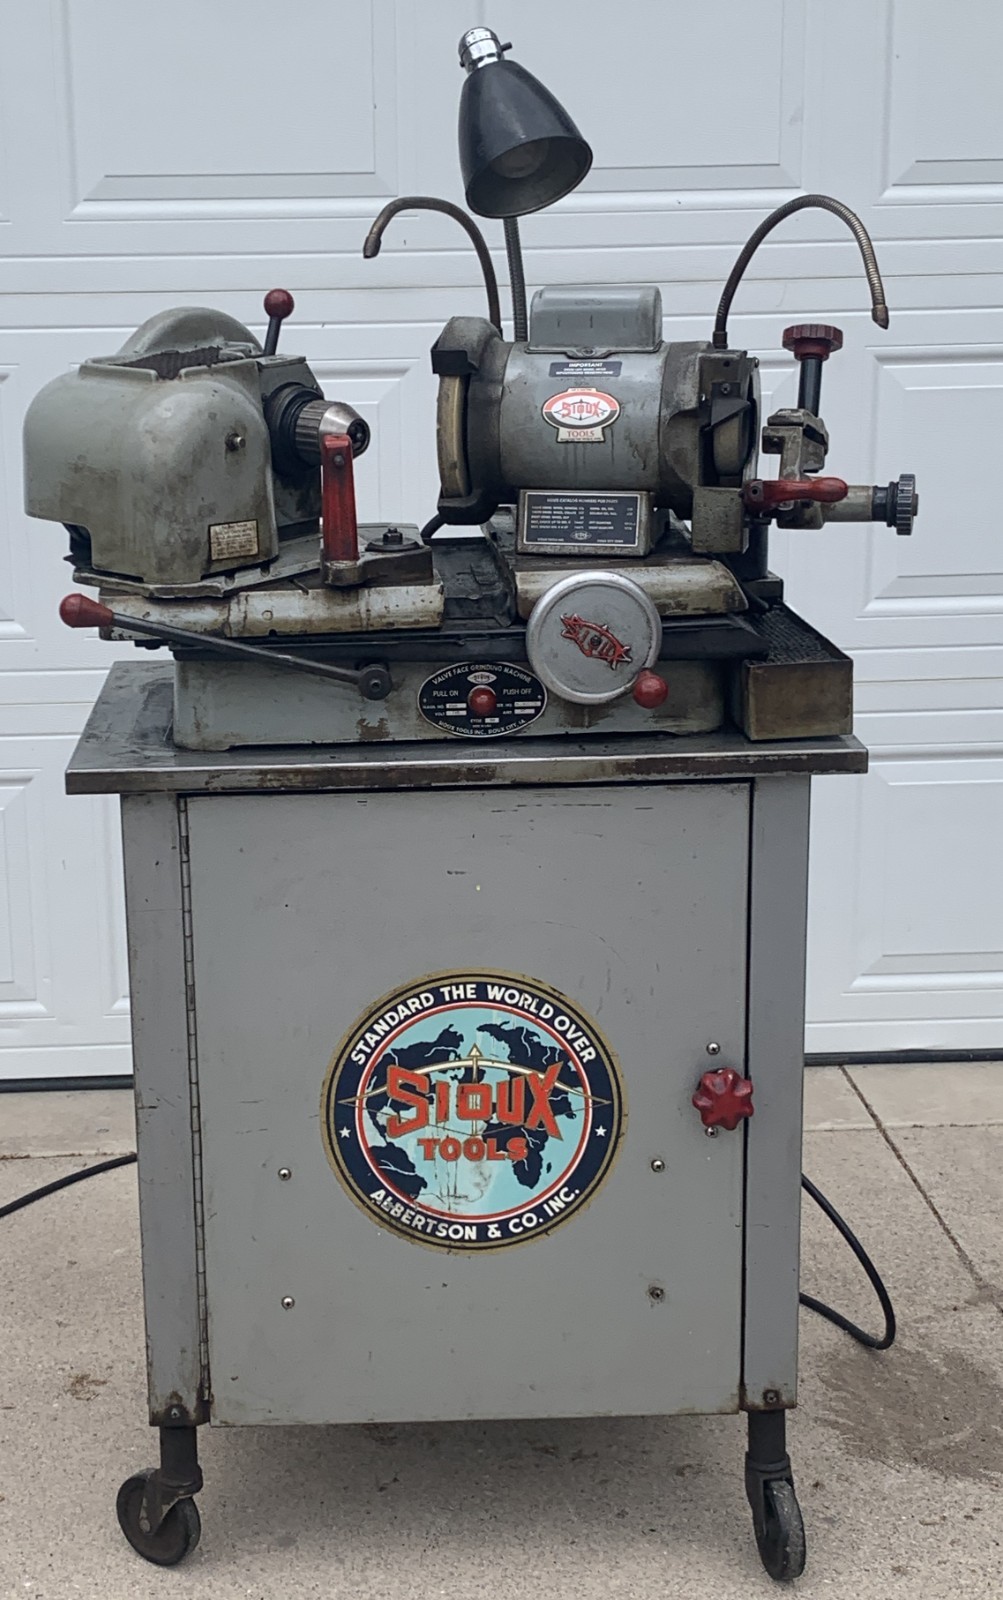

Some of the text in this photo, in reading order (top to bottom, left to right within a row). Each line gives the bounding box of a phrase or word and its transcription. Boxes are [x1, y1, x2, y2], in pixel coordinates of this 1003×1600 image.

[561, 401, 600, 418] SIOUX
[432, 672, 452, 685] VALVE
[453, 666, 469, 676] FACE
[504, 667, 532, 684] MACHINE
[456, 726, 474, 735] TOOLS
[351, 984, 597, 1065] STANDARD THE WORLD OVER
[387, 1061, 564, 1141] SIOUX
[417, 1136, 529, 1161] TOOLS
[370, 1187, 580, 1240] ALBERTSON & CO. INC.
